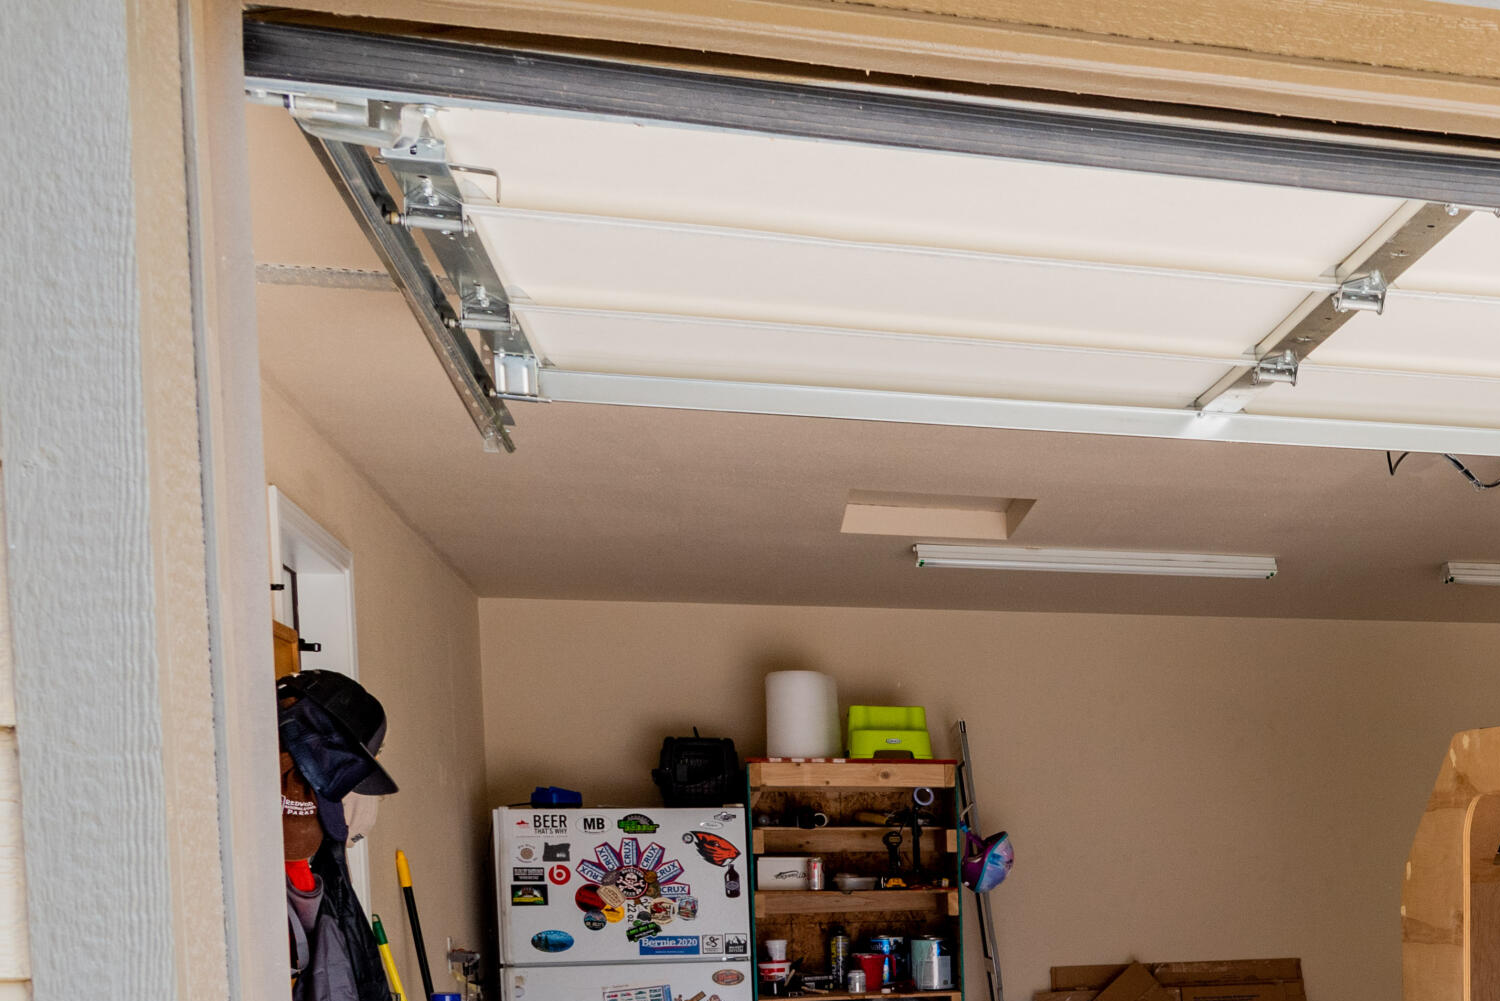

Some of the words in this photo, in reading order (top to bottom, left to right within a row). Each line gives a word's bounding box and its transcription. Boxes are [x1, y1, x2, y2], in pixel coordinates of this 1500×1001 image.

[533, 815, 567, 828] BEER
[583, 818, 605, 831] MB
[597, 848, 615, 871] CRUX
[623, 841, 632, 865] CRUX
[641, 845, 658, 868] CRUX
[580, 865, 603, 882] CRUX
[656, 862, 678, 878] CRUX
[660, 885, 687, 894] CRUX
[641, 938, 676, 947] Bernie
[677, 938, 698, 947] 2020
